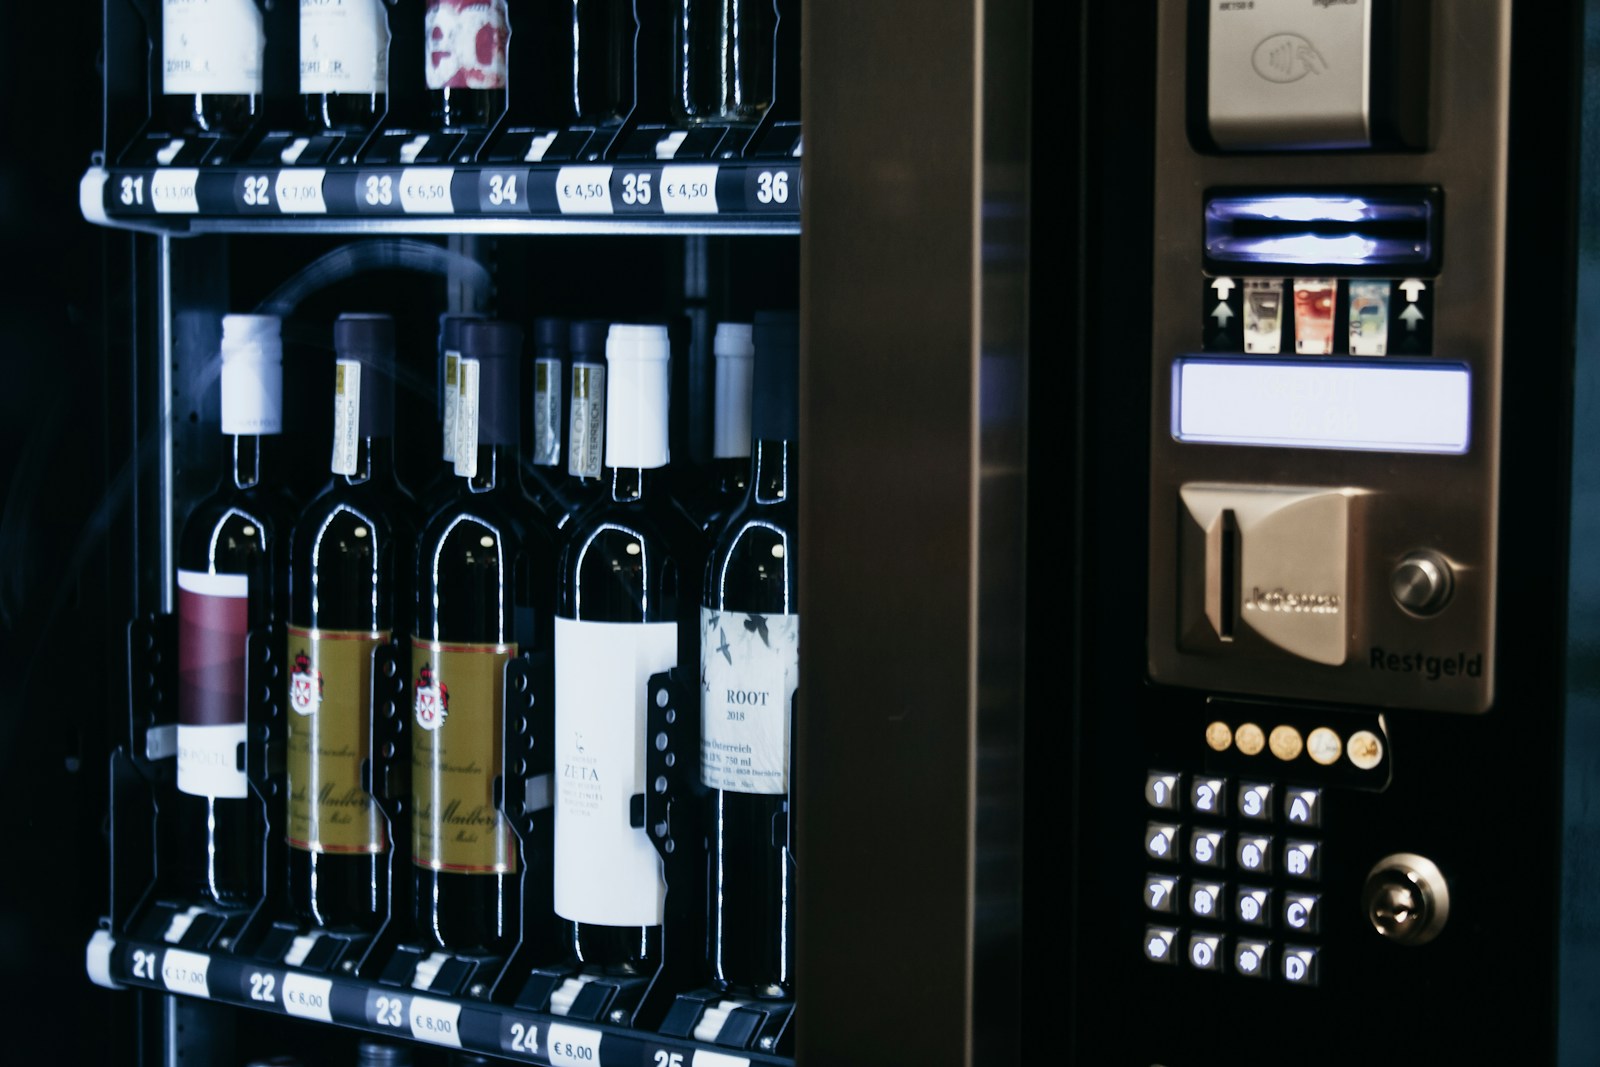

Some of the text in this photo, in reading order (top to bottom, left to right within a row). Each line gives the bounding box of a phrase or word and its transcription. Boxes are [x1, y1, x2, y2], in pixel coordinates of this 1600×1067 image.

[120, 175, 144, 206] 31
[243, 175, 269, 205] 32
[282, 185, 316, 199] € 7,00
[365, 175, 393, 205] 33
[407, 185, 444, 199] € 6,50
[489, 174, 518, 205] 34
[563, 184, 603, 199] € 4,50
[622, 173, 652, 205] 35
[667, 183, 708, 199] € 4,50
[757, 171, 789, 204] 36
[585, 403, 599, 472] ÖSTERREICH
[1370, 649, 1483, 681] Restgeld
[726, 689, 770, 707] ROOT
[726, 711, 746, 722] 2018
[711, 738, 752, 754] Österreich
[564, 764, 600, 782] ZETA
[740, 757, 752, 767] ml
[1153, 781, 1307, 822] 1 2 3 A
[1150, 832, 1168, 856] 4
[1195, 837, 1213, 863] 5
[1150, 884, 1307, 928] 7 8 9 C
[132, 950, 156, 981] 21
[1193, 942, 1212, 967] 0
[1286, 955, 1305, 980] D
[175, 970, 205, 986] 17,00
[250, 973, 276, 1003] 22
[289, 991, 323, 1008] € 8,00
[376, 996, 402, 1028] 23
[416, 1016, 452, 1033] € 8,00
[511, 1023, 539, 1054] 24
[554, 1042, 593, 1060] € 8,00
[654, 1049, 684, 1067] 25
